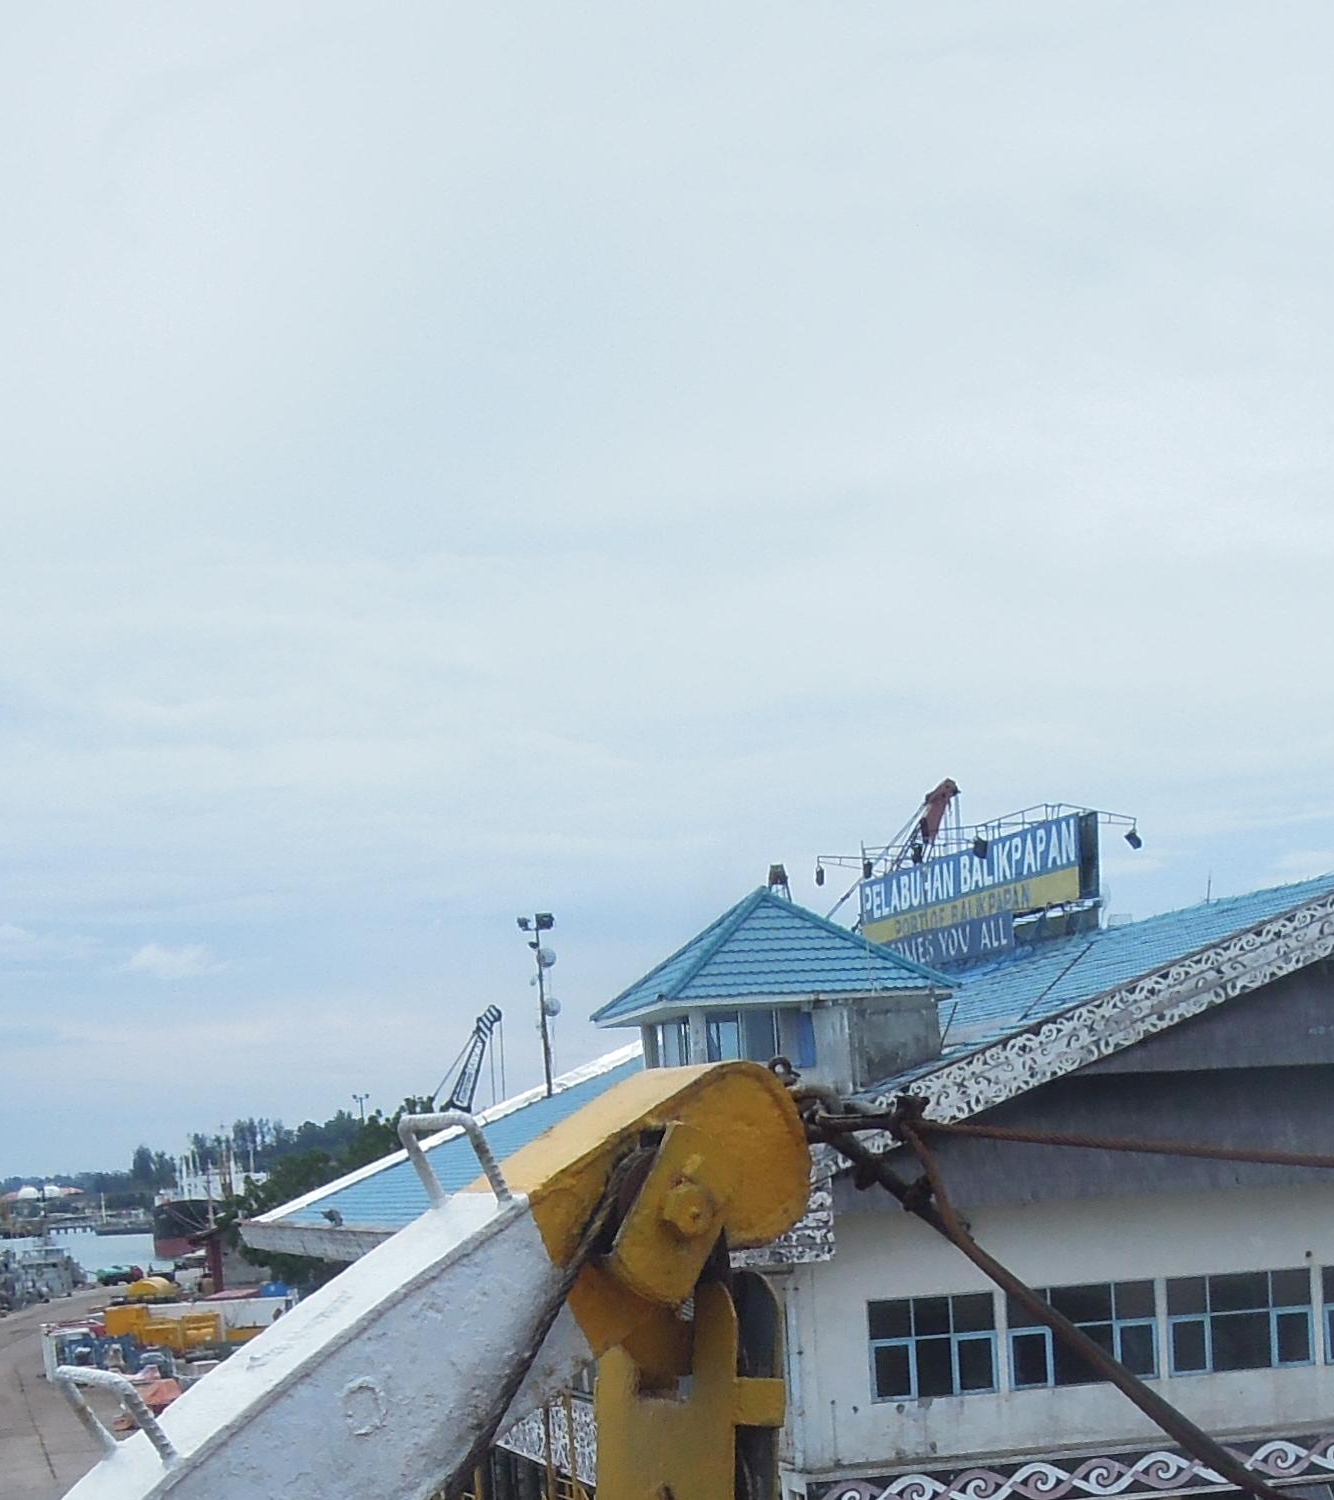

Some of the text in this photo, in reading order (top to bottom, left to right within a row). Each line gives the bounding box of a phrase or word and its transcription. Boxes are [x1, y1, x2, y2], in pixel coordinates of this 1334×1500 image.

[864, 818, 1077, 919] PELABUHAN BALIKPAPAN
[928, 907, 945, 927] OF
[951, 883, 1031, 921] BALIKPAPAN
[939, 924, 971, 957] YOU
[981, 917, 1008, 949] ALL
